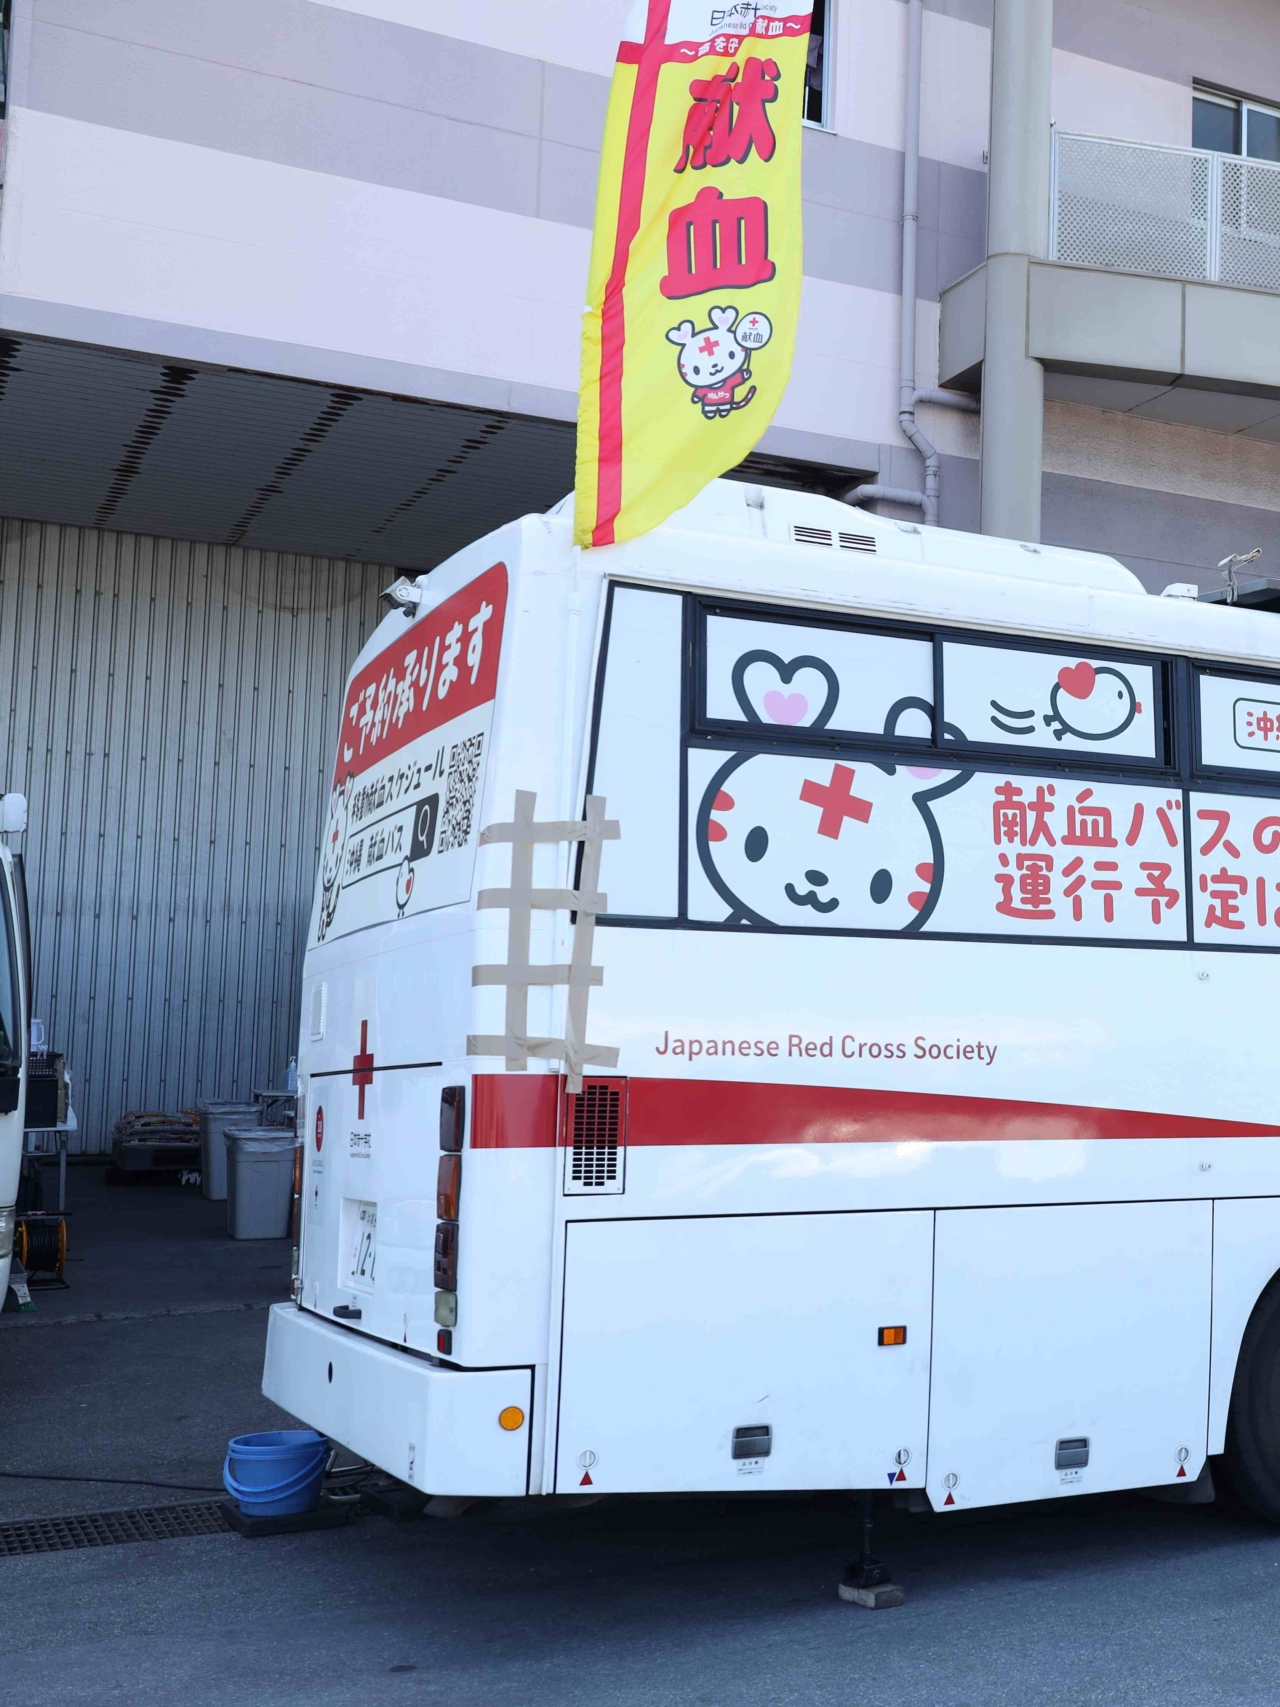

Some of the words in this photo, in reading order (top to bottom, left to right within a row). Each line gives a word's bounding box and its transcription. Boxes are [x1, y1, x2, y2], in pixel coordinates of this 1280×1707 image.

[660, 56, 779, 300] 献血
[343, 601, 493, 763] ご予約承ります
[655, 1031, 780, 1062] Japanese
[788, 1034, 834, 1059] Red
[841, 1035, 907, 1060] Cross
[913, 1036, 998, 1066] Society
